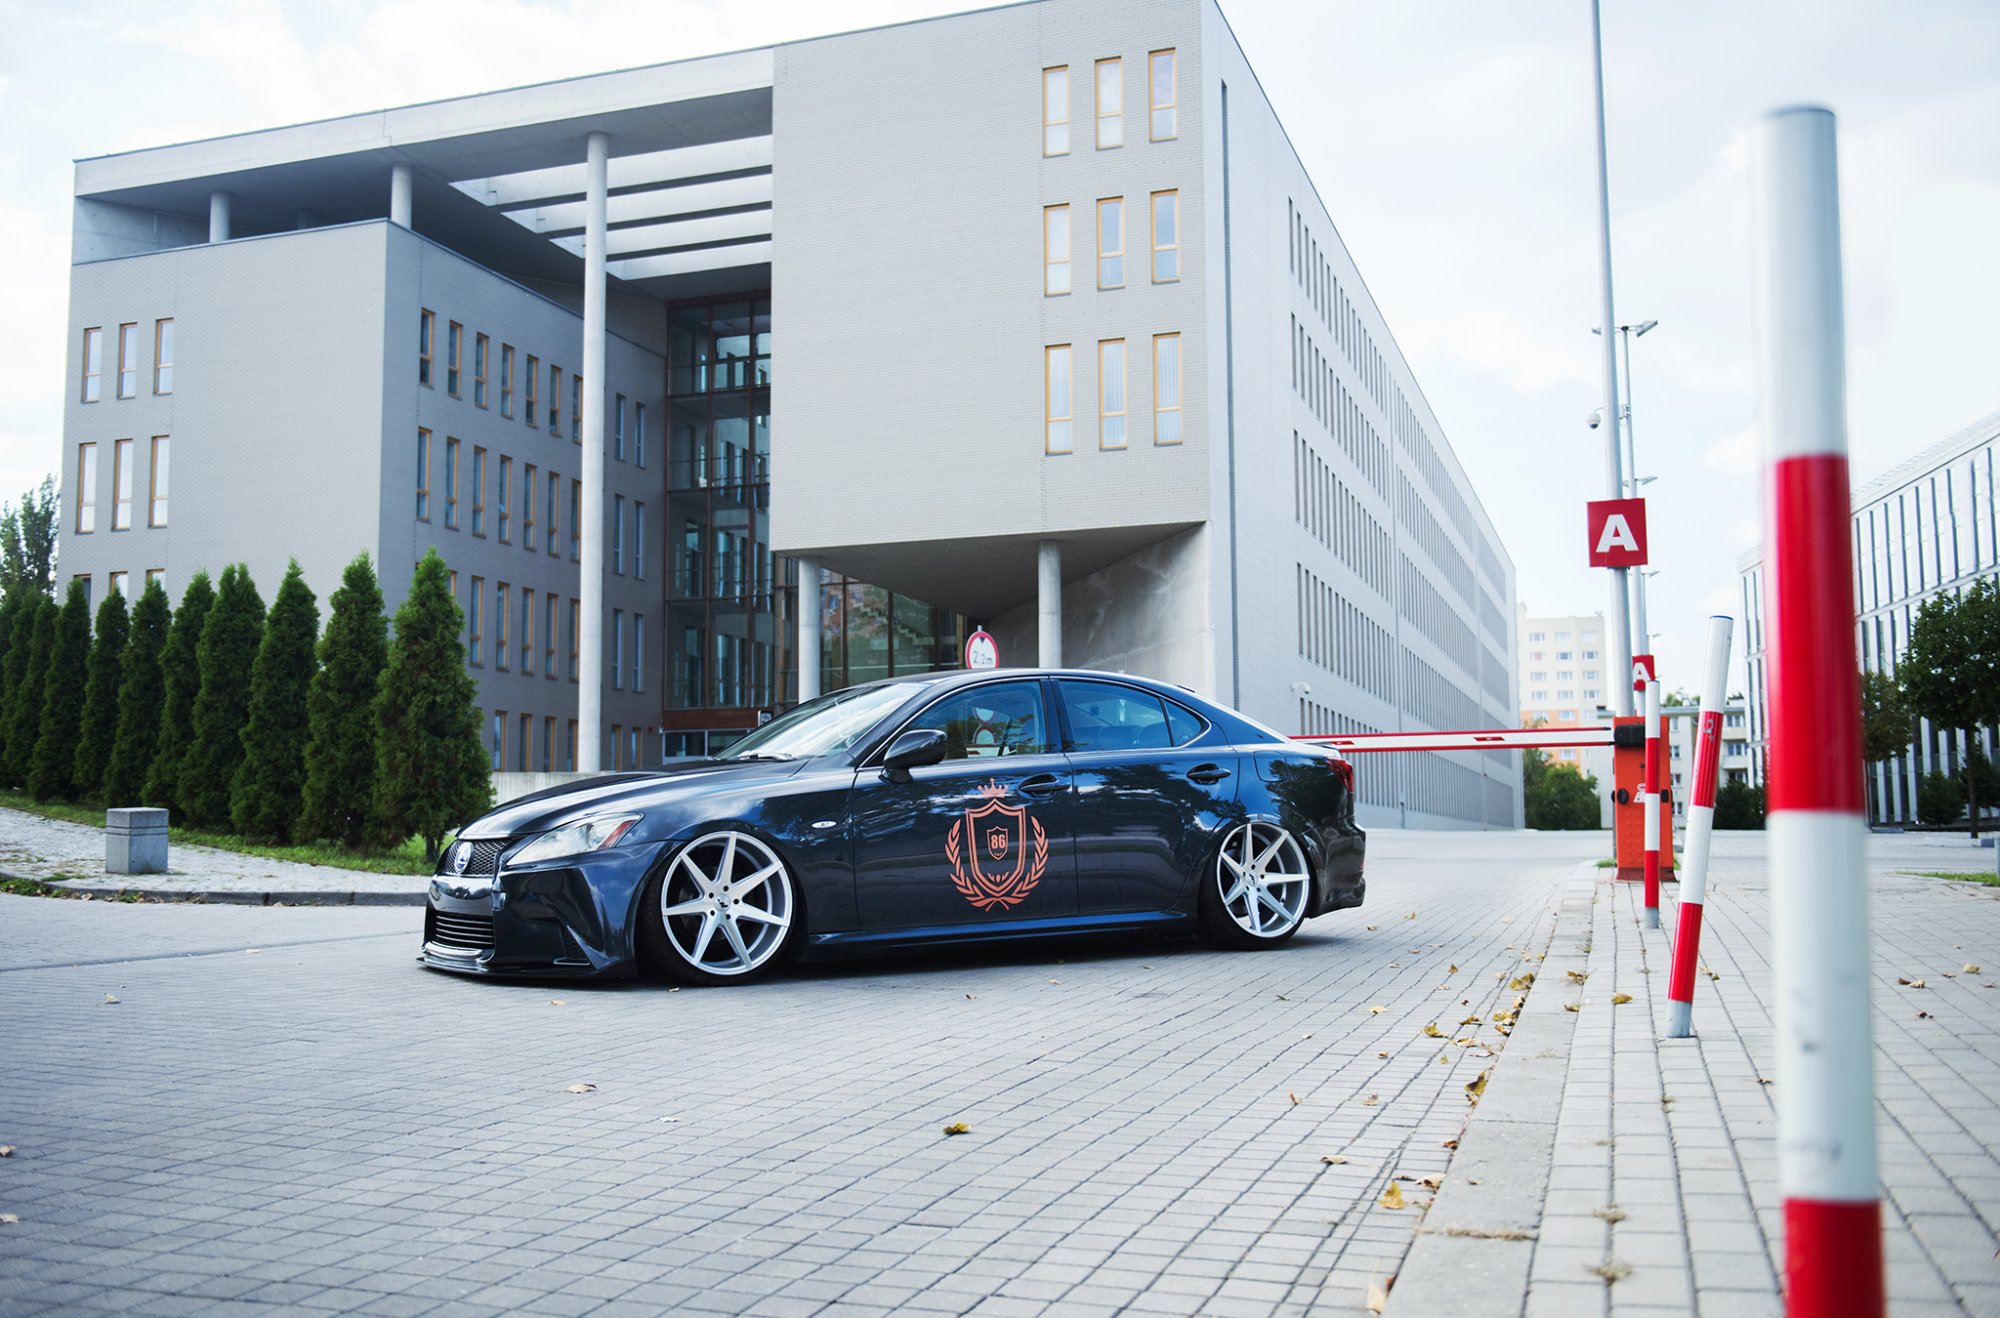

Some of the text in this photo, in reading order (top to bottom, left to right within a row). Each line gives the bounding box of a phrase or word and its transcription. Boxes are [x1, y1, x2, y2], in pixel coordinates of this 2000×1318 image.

[1596, 514, 1639, 552] A
[1632, 662, 1651, 682] A
[991, 834, 1006, 849] 86
